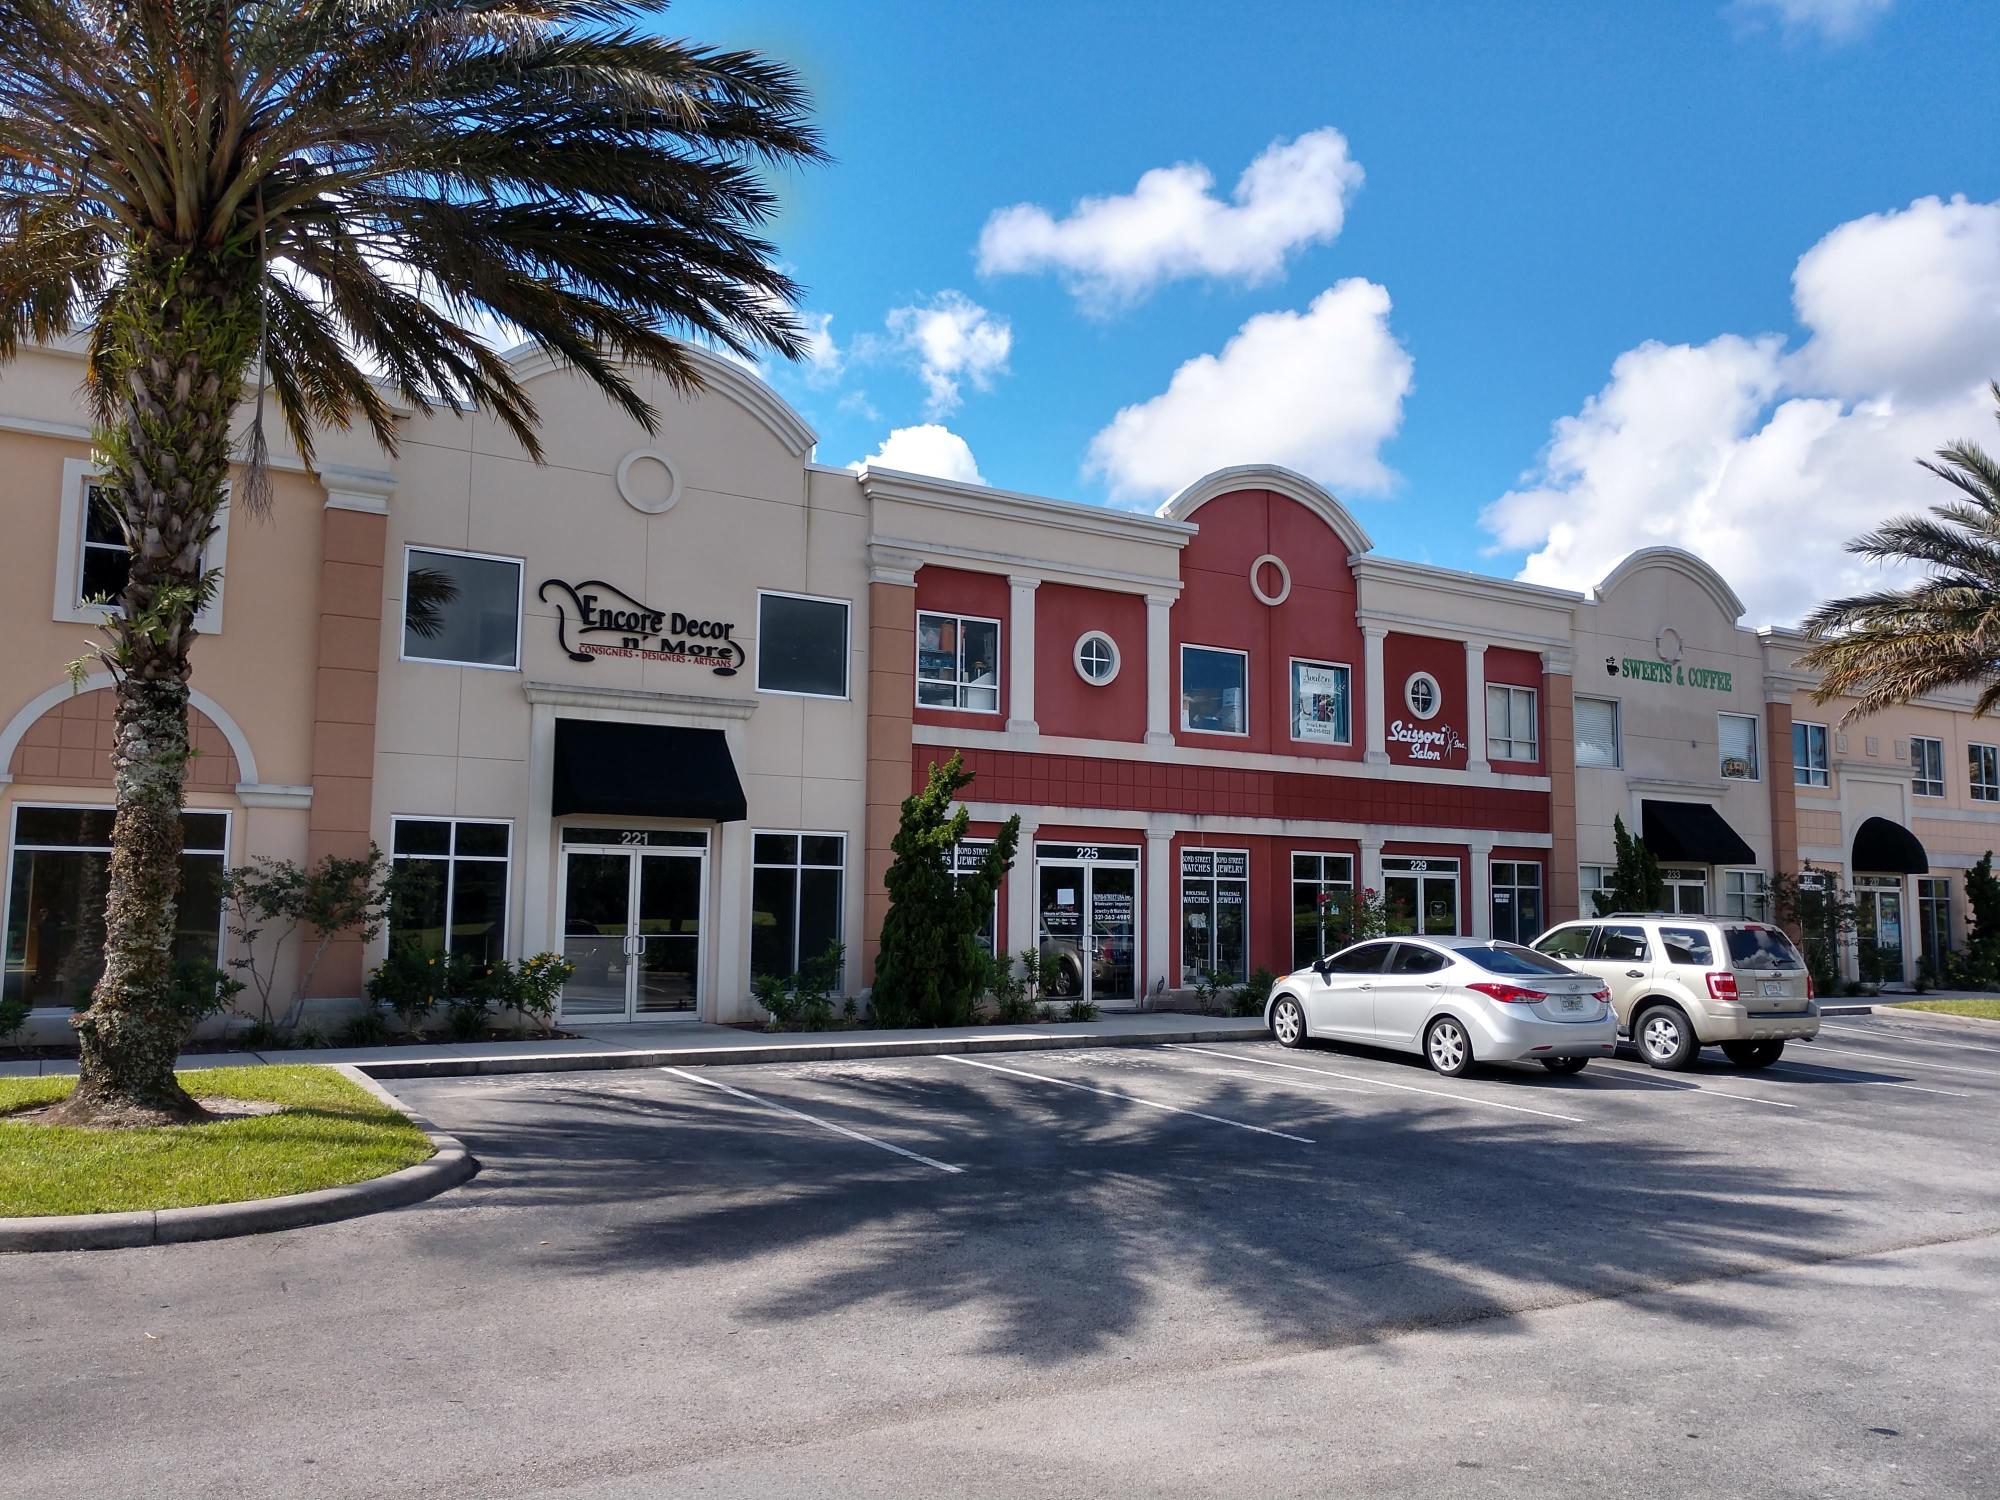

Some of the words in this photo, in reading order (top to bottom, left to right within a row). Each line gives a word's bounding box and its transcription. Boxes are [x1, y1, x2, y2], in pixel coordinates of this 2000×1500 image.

[583, 594, 663, 633] Encore
[671, 612, 735, 640] Decor
[661, 639, 734, 659] More
[579, 645, 633, 659] CONSIGNERS
[642, 651, 686, 664] DESIGNERS
[693, 656, 732, 668] ARTISANS
[1622, 658, 1672, 684] SWEETS
[1676, 665, 1685, 686] &
[1688, 667, 1732, 692] COFFEE
[1408, 743, 1441, 760] Salon
[621, 832, 649, 846] 221
[1076, 847, 1099, 859] 225
[957, 856, 986, 865] JEWELR
[1410, 860, 1427, 871] 229
[1182, 863, 1211, 873] WATCHES
[1216, 865, 1244, 873] JEWELRY
[1667, 870, 1681, 879] 233
[1183, 896, 1210, 904] WATCHES
